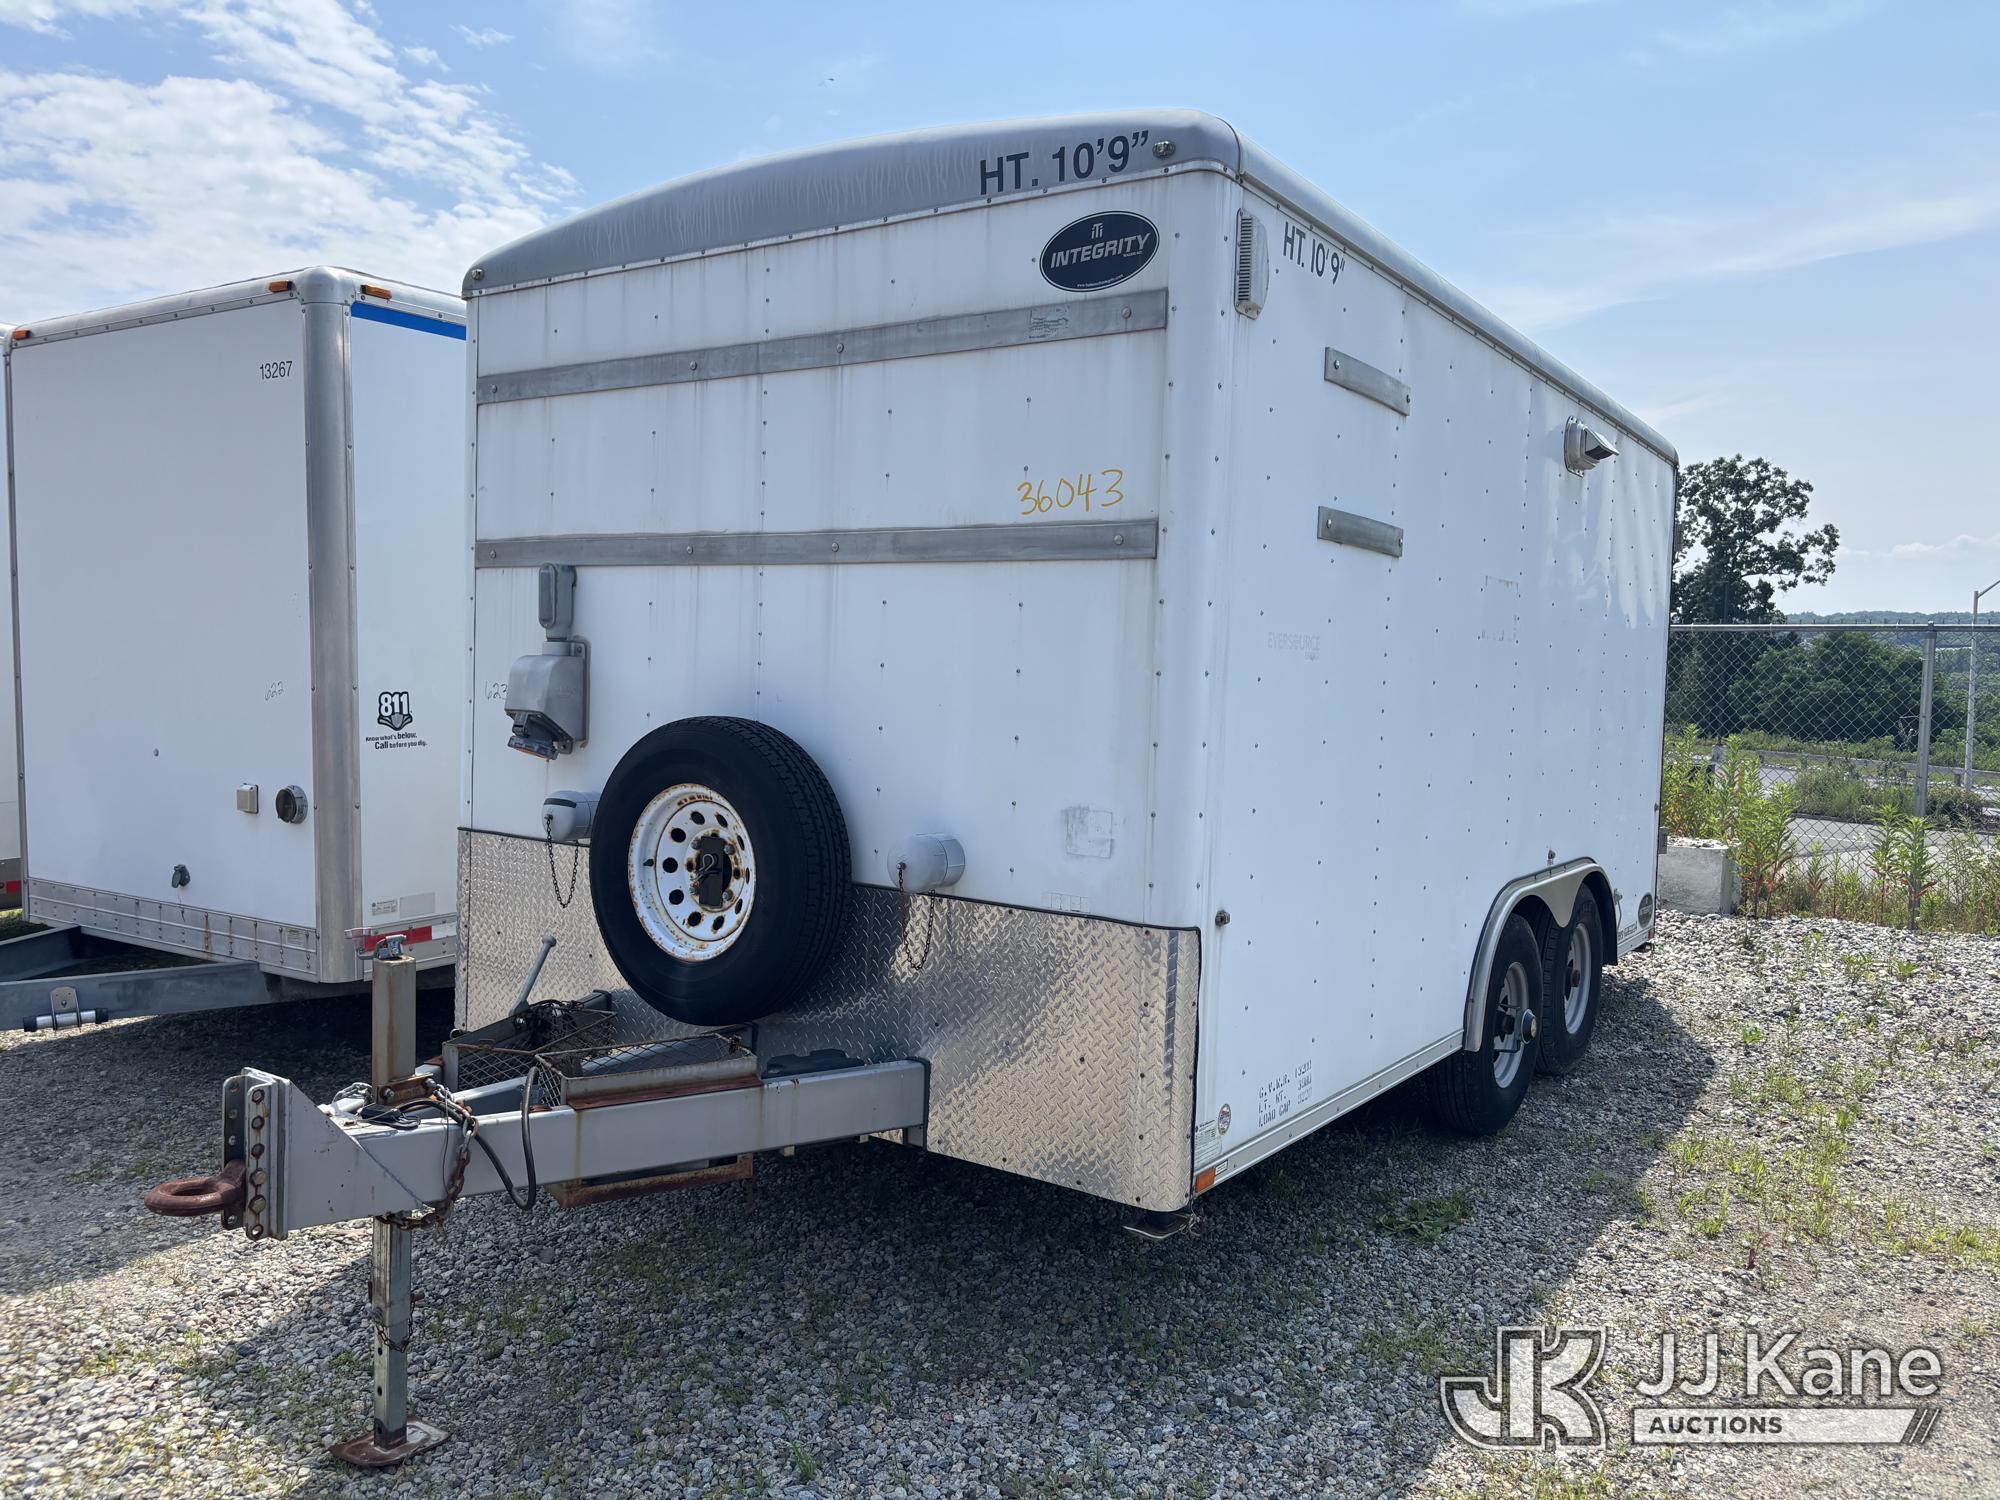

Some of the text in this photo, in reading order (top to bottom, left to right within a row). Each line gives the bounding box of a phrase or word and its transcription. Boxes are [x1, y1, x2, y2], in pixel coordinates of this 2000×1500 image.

[980, 130, 1149, 195] HT. 10'9"
[1050, 232, 1151, 269] INTEGRITY
[1283, 221, 1346, 285] HT. 10'9"
[259, 360, 293, 380] 13267
[1017, 469, 1124, 516] 36043
[379, 691, 409, 717] 811
[374, 741, 389, 750] Call
[389, 741, 408, 749] before
[1258, 1108, 1276, 1127] LOAD
[1278, 1099, 1291, 1117] CAP
